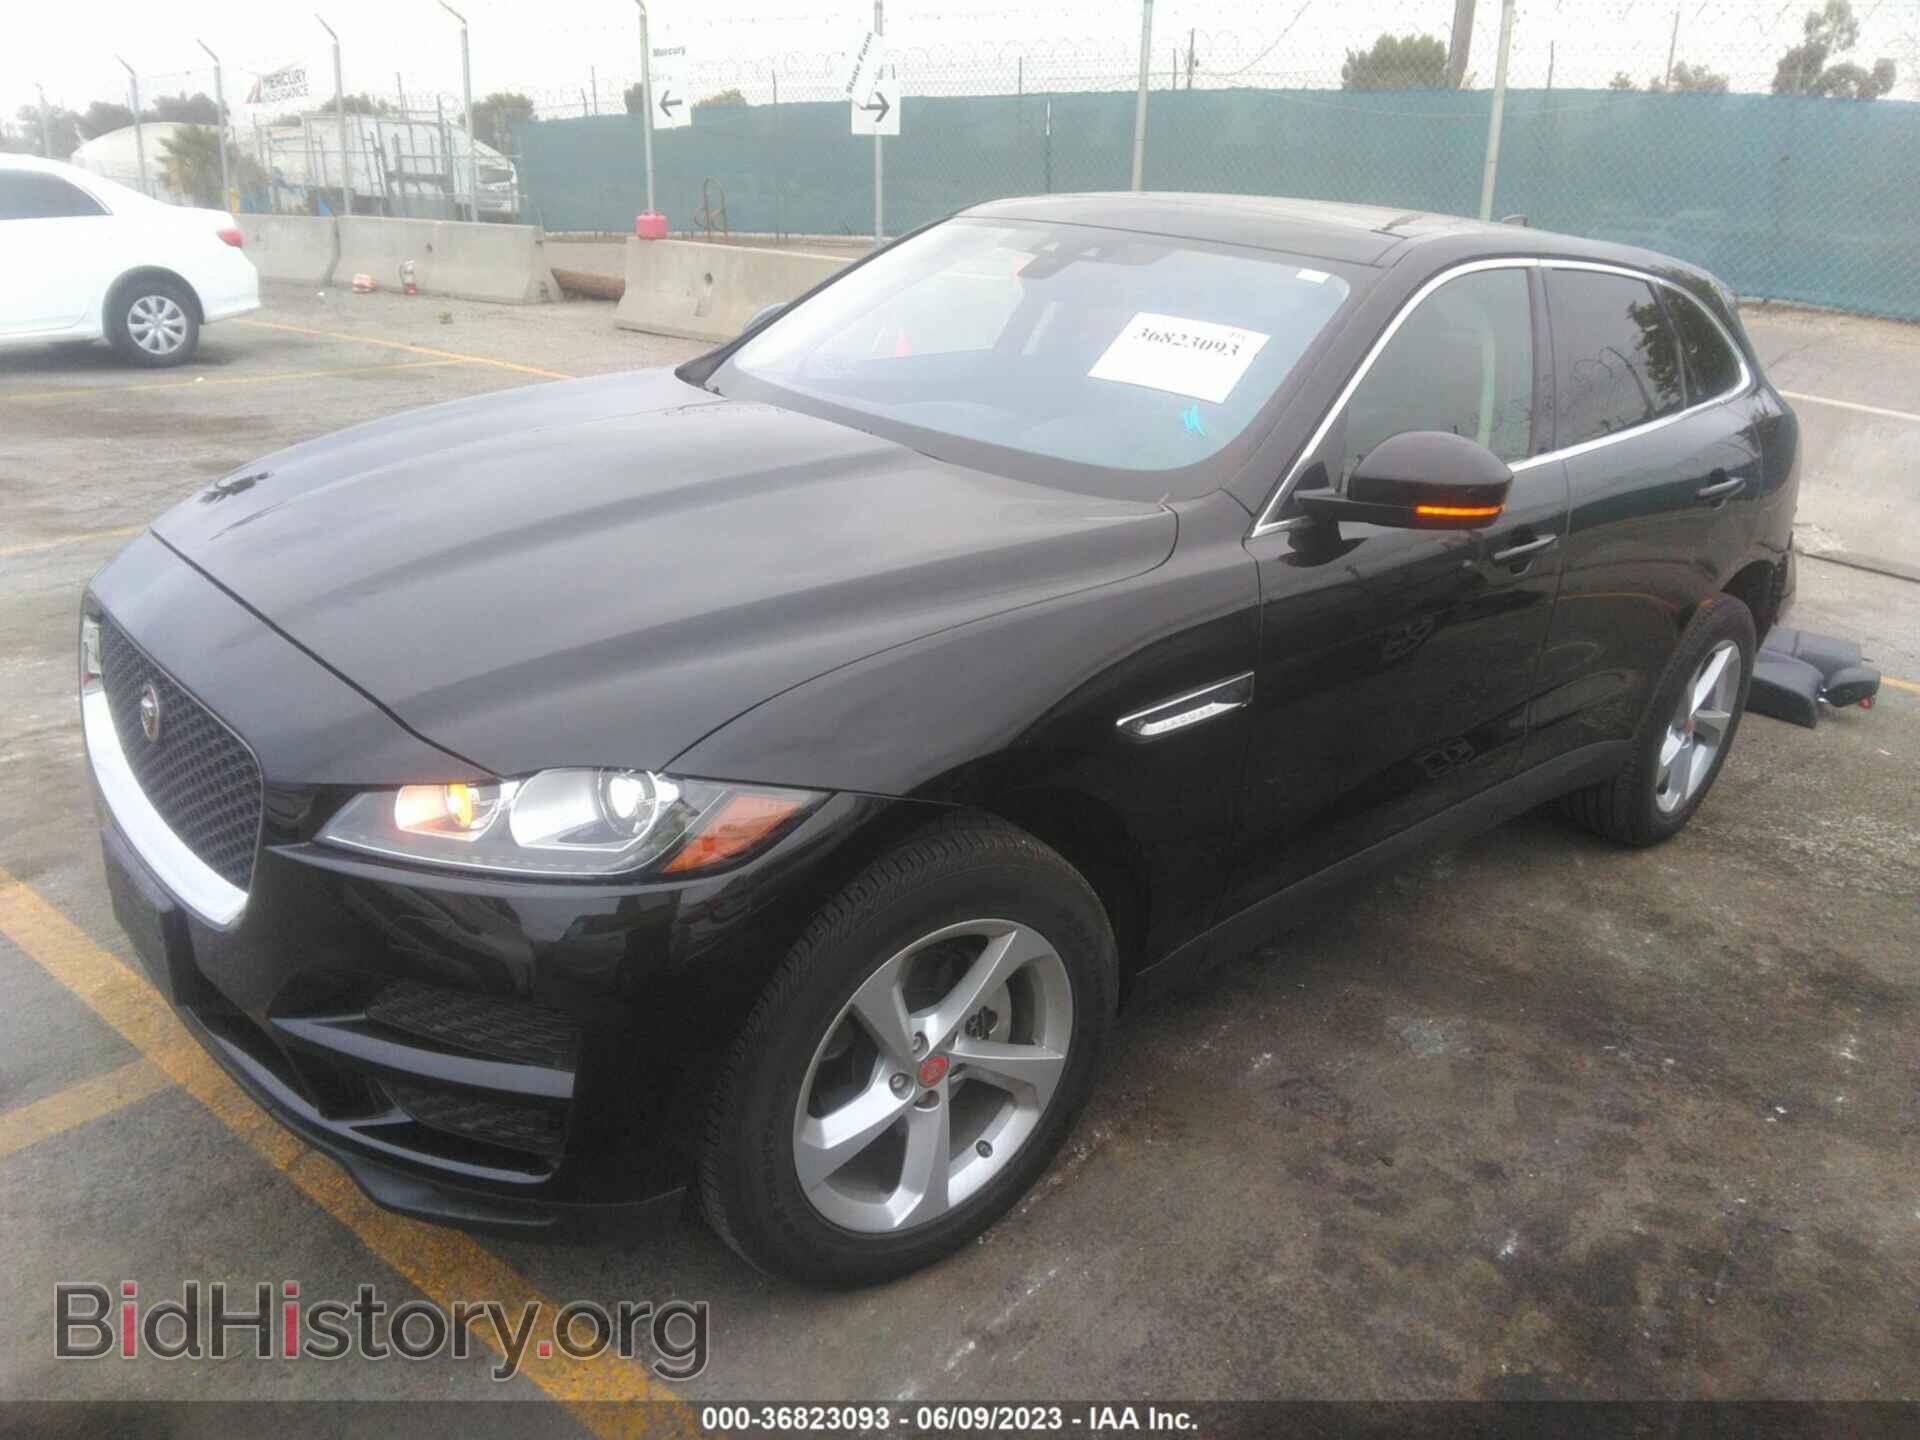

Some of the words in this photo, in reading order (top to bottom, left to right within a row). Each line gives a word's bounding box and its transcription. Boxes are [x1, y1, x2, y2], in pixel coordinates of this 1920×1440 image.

[653, 45, 686, 57] Mercury
[845, 64, 860, 94] State
[857, 32, 873, 62] Farm
[1133, 327, 1240, 357] 36823093
